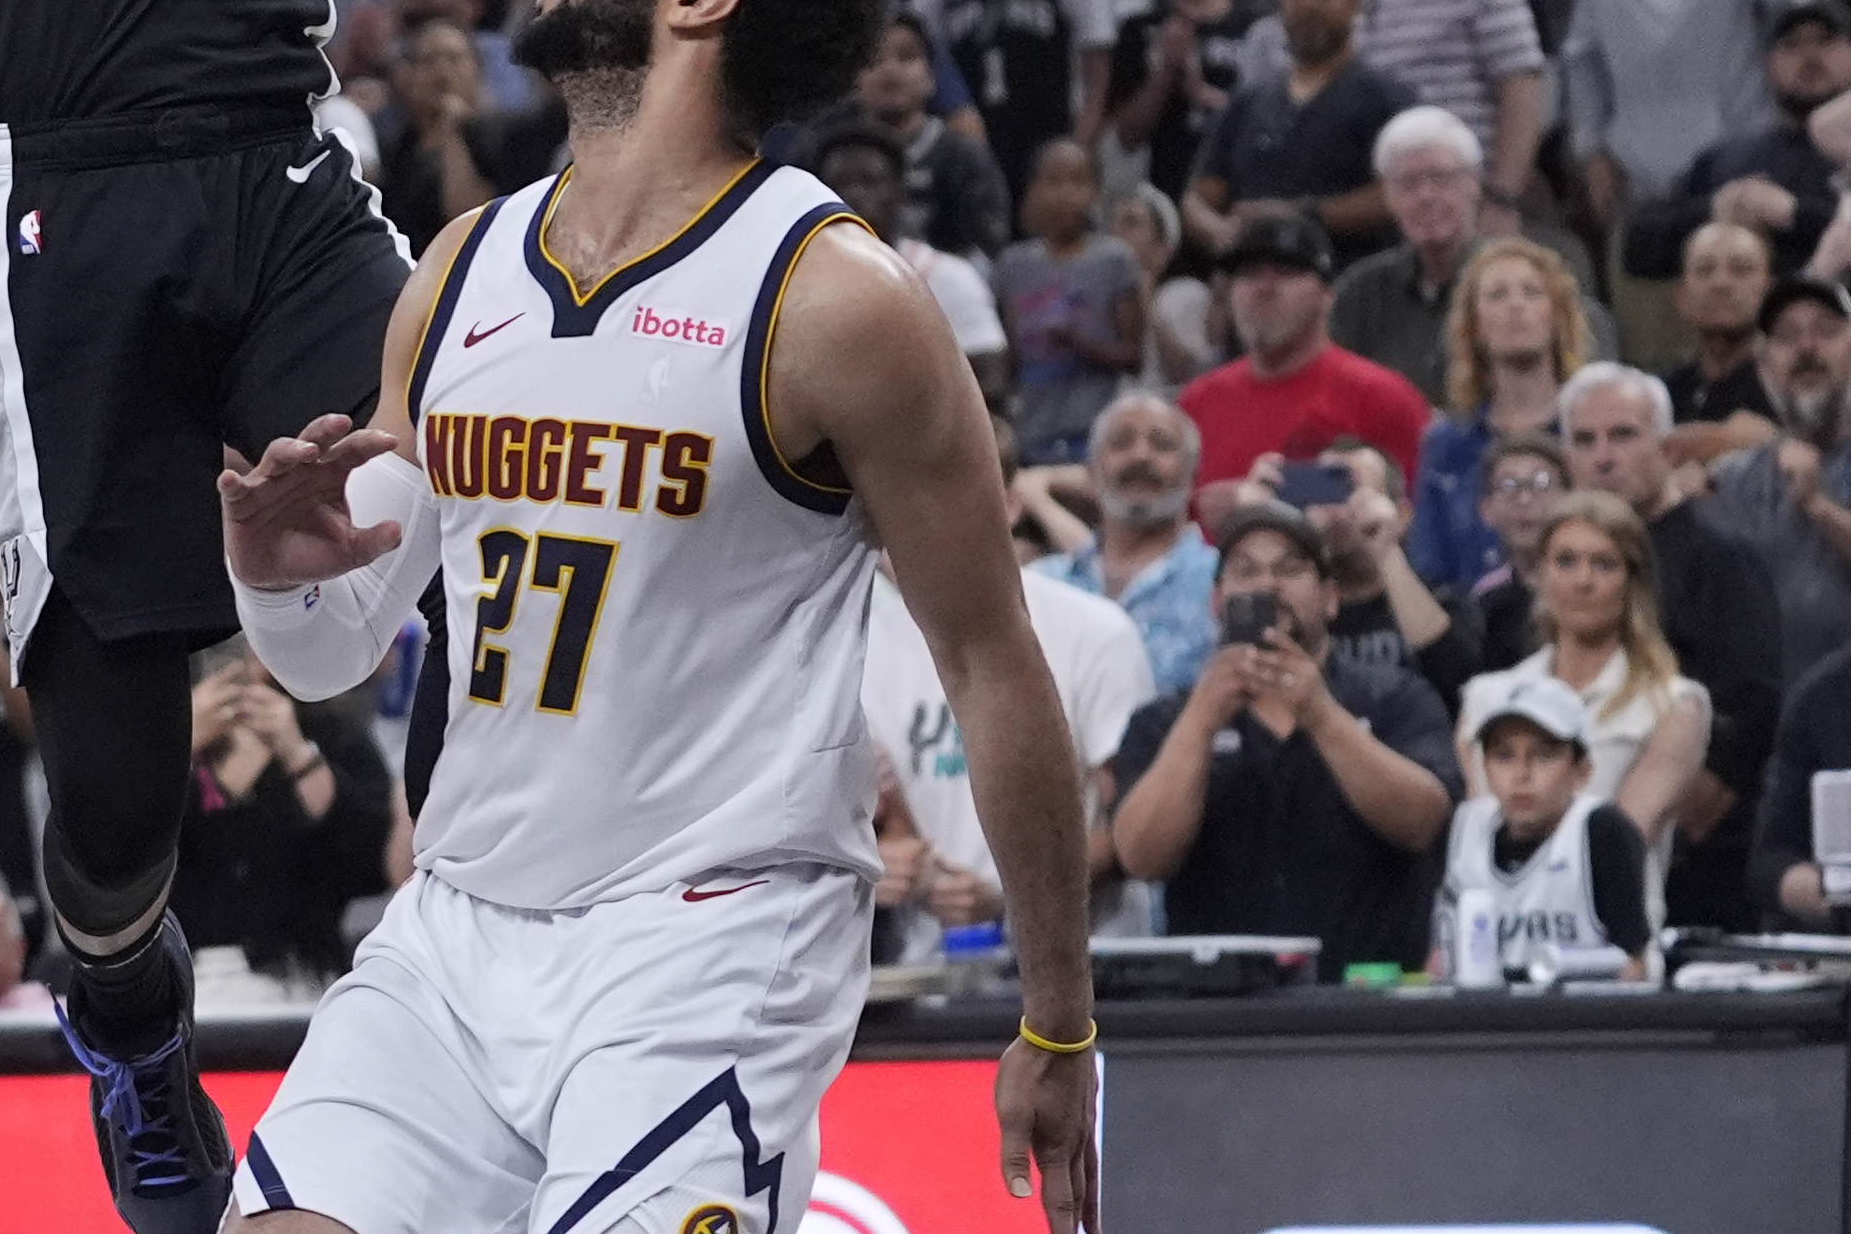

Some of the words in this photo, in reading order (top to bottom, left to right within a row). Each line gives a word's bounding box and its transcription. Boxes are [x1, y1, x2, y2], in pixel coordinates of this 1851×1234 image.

[632, 306, 725, 347] ibotta
[425, 412, 715, 518] NUGGETS
[469, 525, 620, 717] 27
